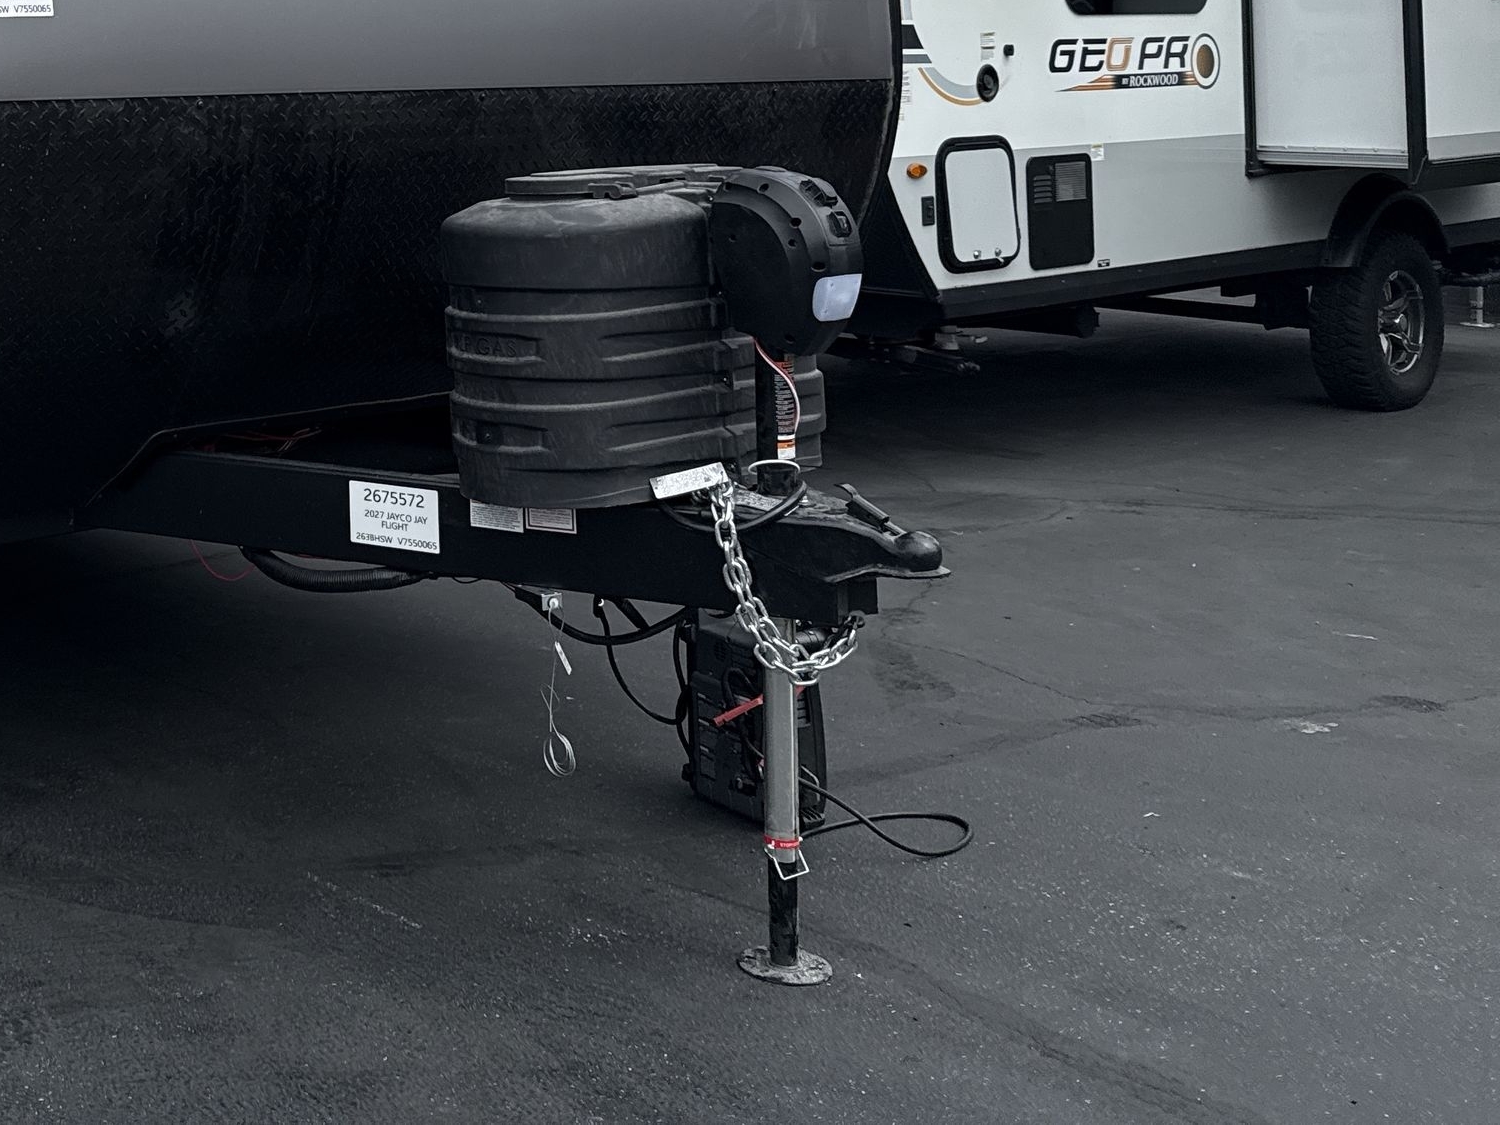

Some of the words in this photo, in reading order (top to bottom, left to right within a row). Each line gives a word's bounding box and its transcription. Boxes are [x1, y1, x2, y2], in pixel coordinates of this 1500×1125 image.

[13, 4, 52, 14] V7550065
[1049, 37, 1134, 73] GEO
[1129, 74, 1179, 87] ROCKWOOD
[363, 488, 424, 508] 2675572
[364, 509, 385, 519] 2027
[386, 512, 412, 523] JAYCO
[413, 515, 428, 525] JAY
[381, 520, 409, 531] FLIGHT
